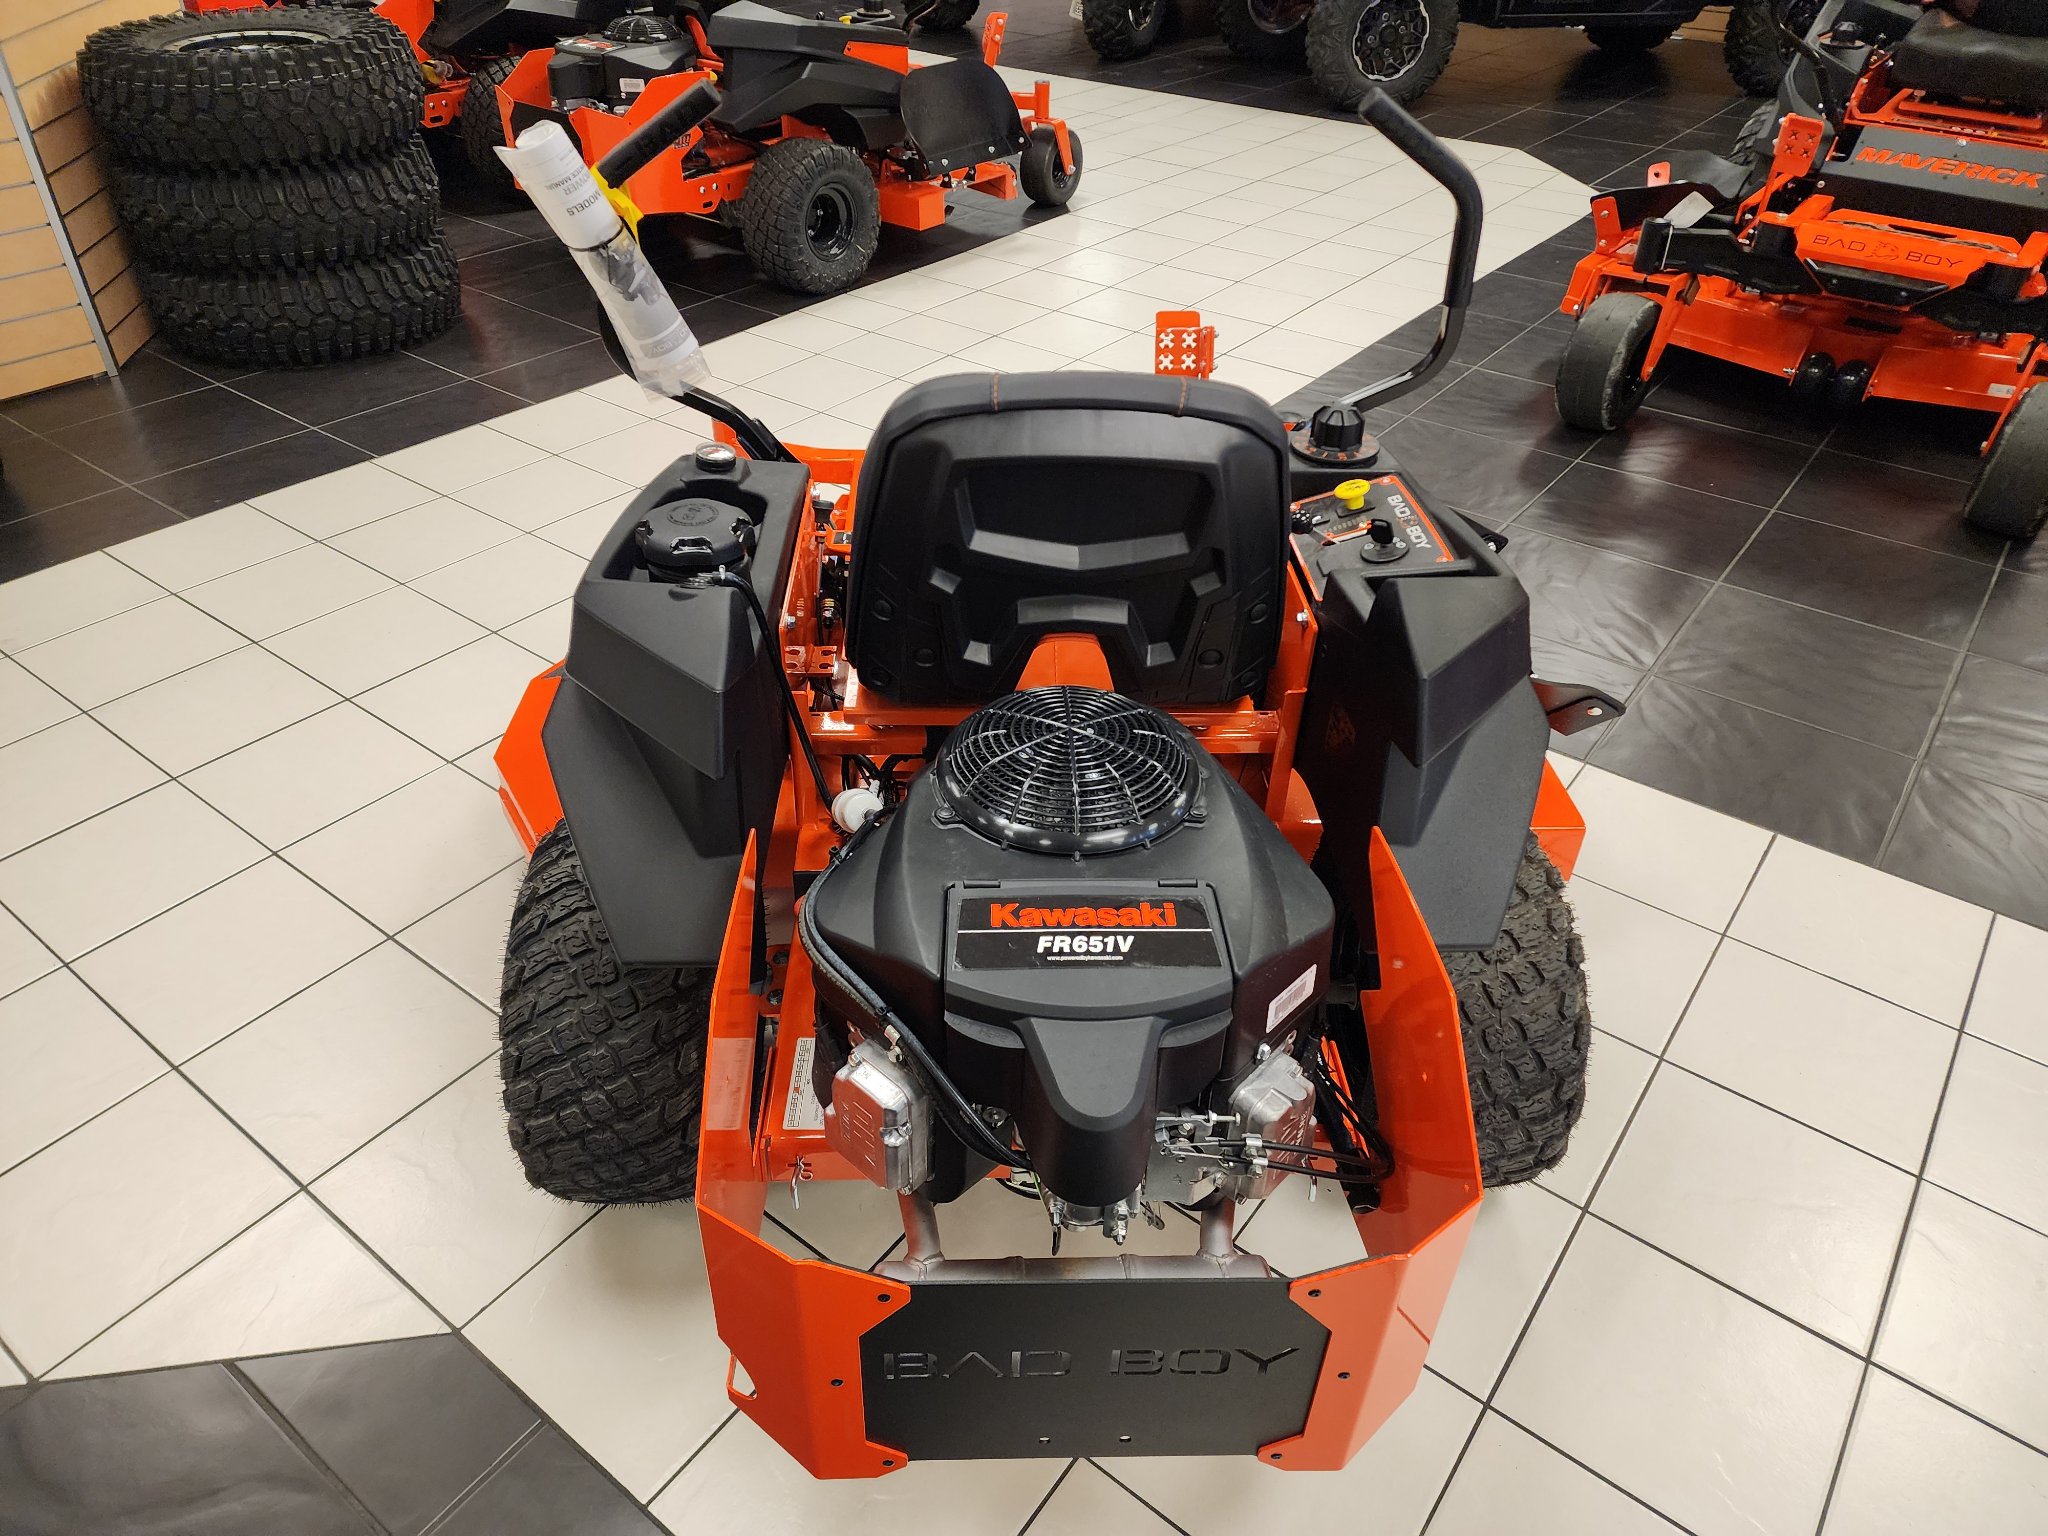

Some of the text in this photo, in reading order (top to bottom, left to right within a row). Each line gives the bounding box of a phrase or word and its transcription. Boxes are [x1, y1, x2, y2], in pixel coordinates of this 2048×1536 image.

[1856, 146, 2047, 189] MAVERICK
[566, 189, 600, 216] MODELS
[1812, 234, 1964, 268] BAD BOY
[1387, 494, 1432, 548] BAD BOY
[990, 902, 1178, 928] Kawasaki
[1036, 934, 1135, 953] FR651V
[882, 1347, 1300, 1380] BAD BOY
